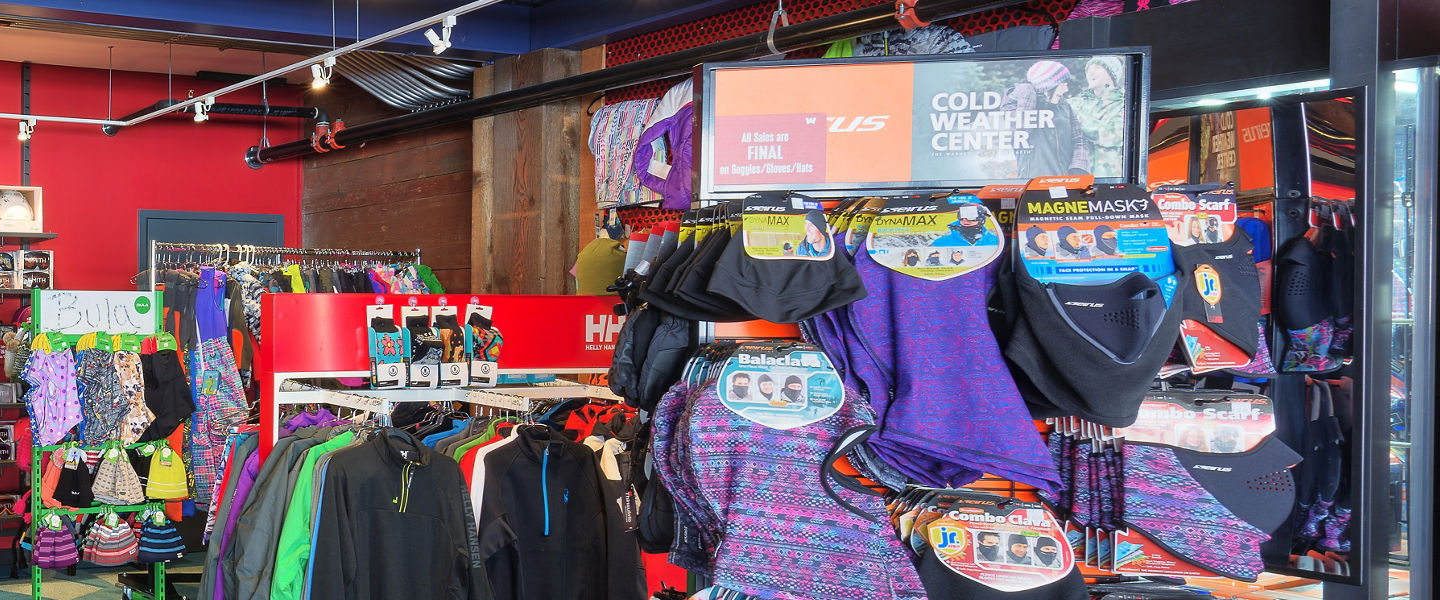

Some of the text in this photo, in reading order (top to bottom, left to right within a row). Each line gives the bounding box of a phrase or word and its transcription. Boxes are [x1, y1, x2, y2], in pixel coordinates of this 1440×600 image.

[931, 91, 1001, 112] COLD
[930, 109, 1056, 131] WEATHER
[741, 131, 789, 142] All Sales are
[747, 145, 783, 160] FINAL
[720, 162, 814, 176] on Goggles/Gloves/Hats
[1027, 199, 1136, 215] MAGNEMASK
[1157, 198, 1231, 211] Combo Scarf
[45, 291, 141, 331] Bula
[738, 353, 822, 368] Balaclava
[1202, 407, 1264, 421] Scarf
[949, 510, 1006, 524] Combo
[1008, 514, 1052, 527] Clava
[460, 485, 481, 569] HELLY HANSEN
[938, 527, 960, 549] jr.
